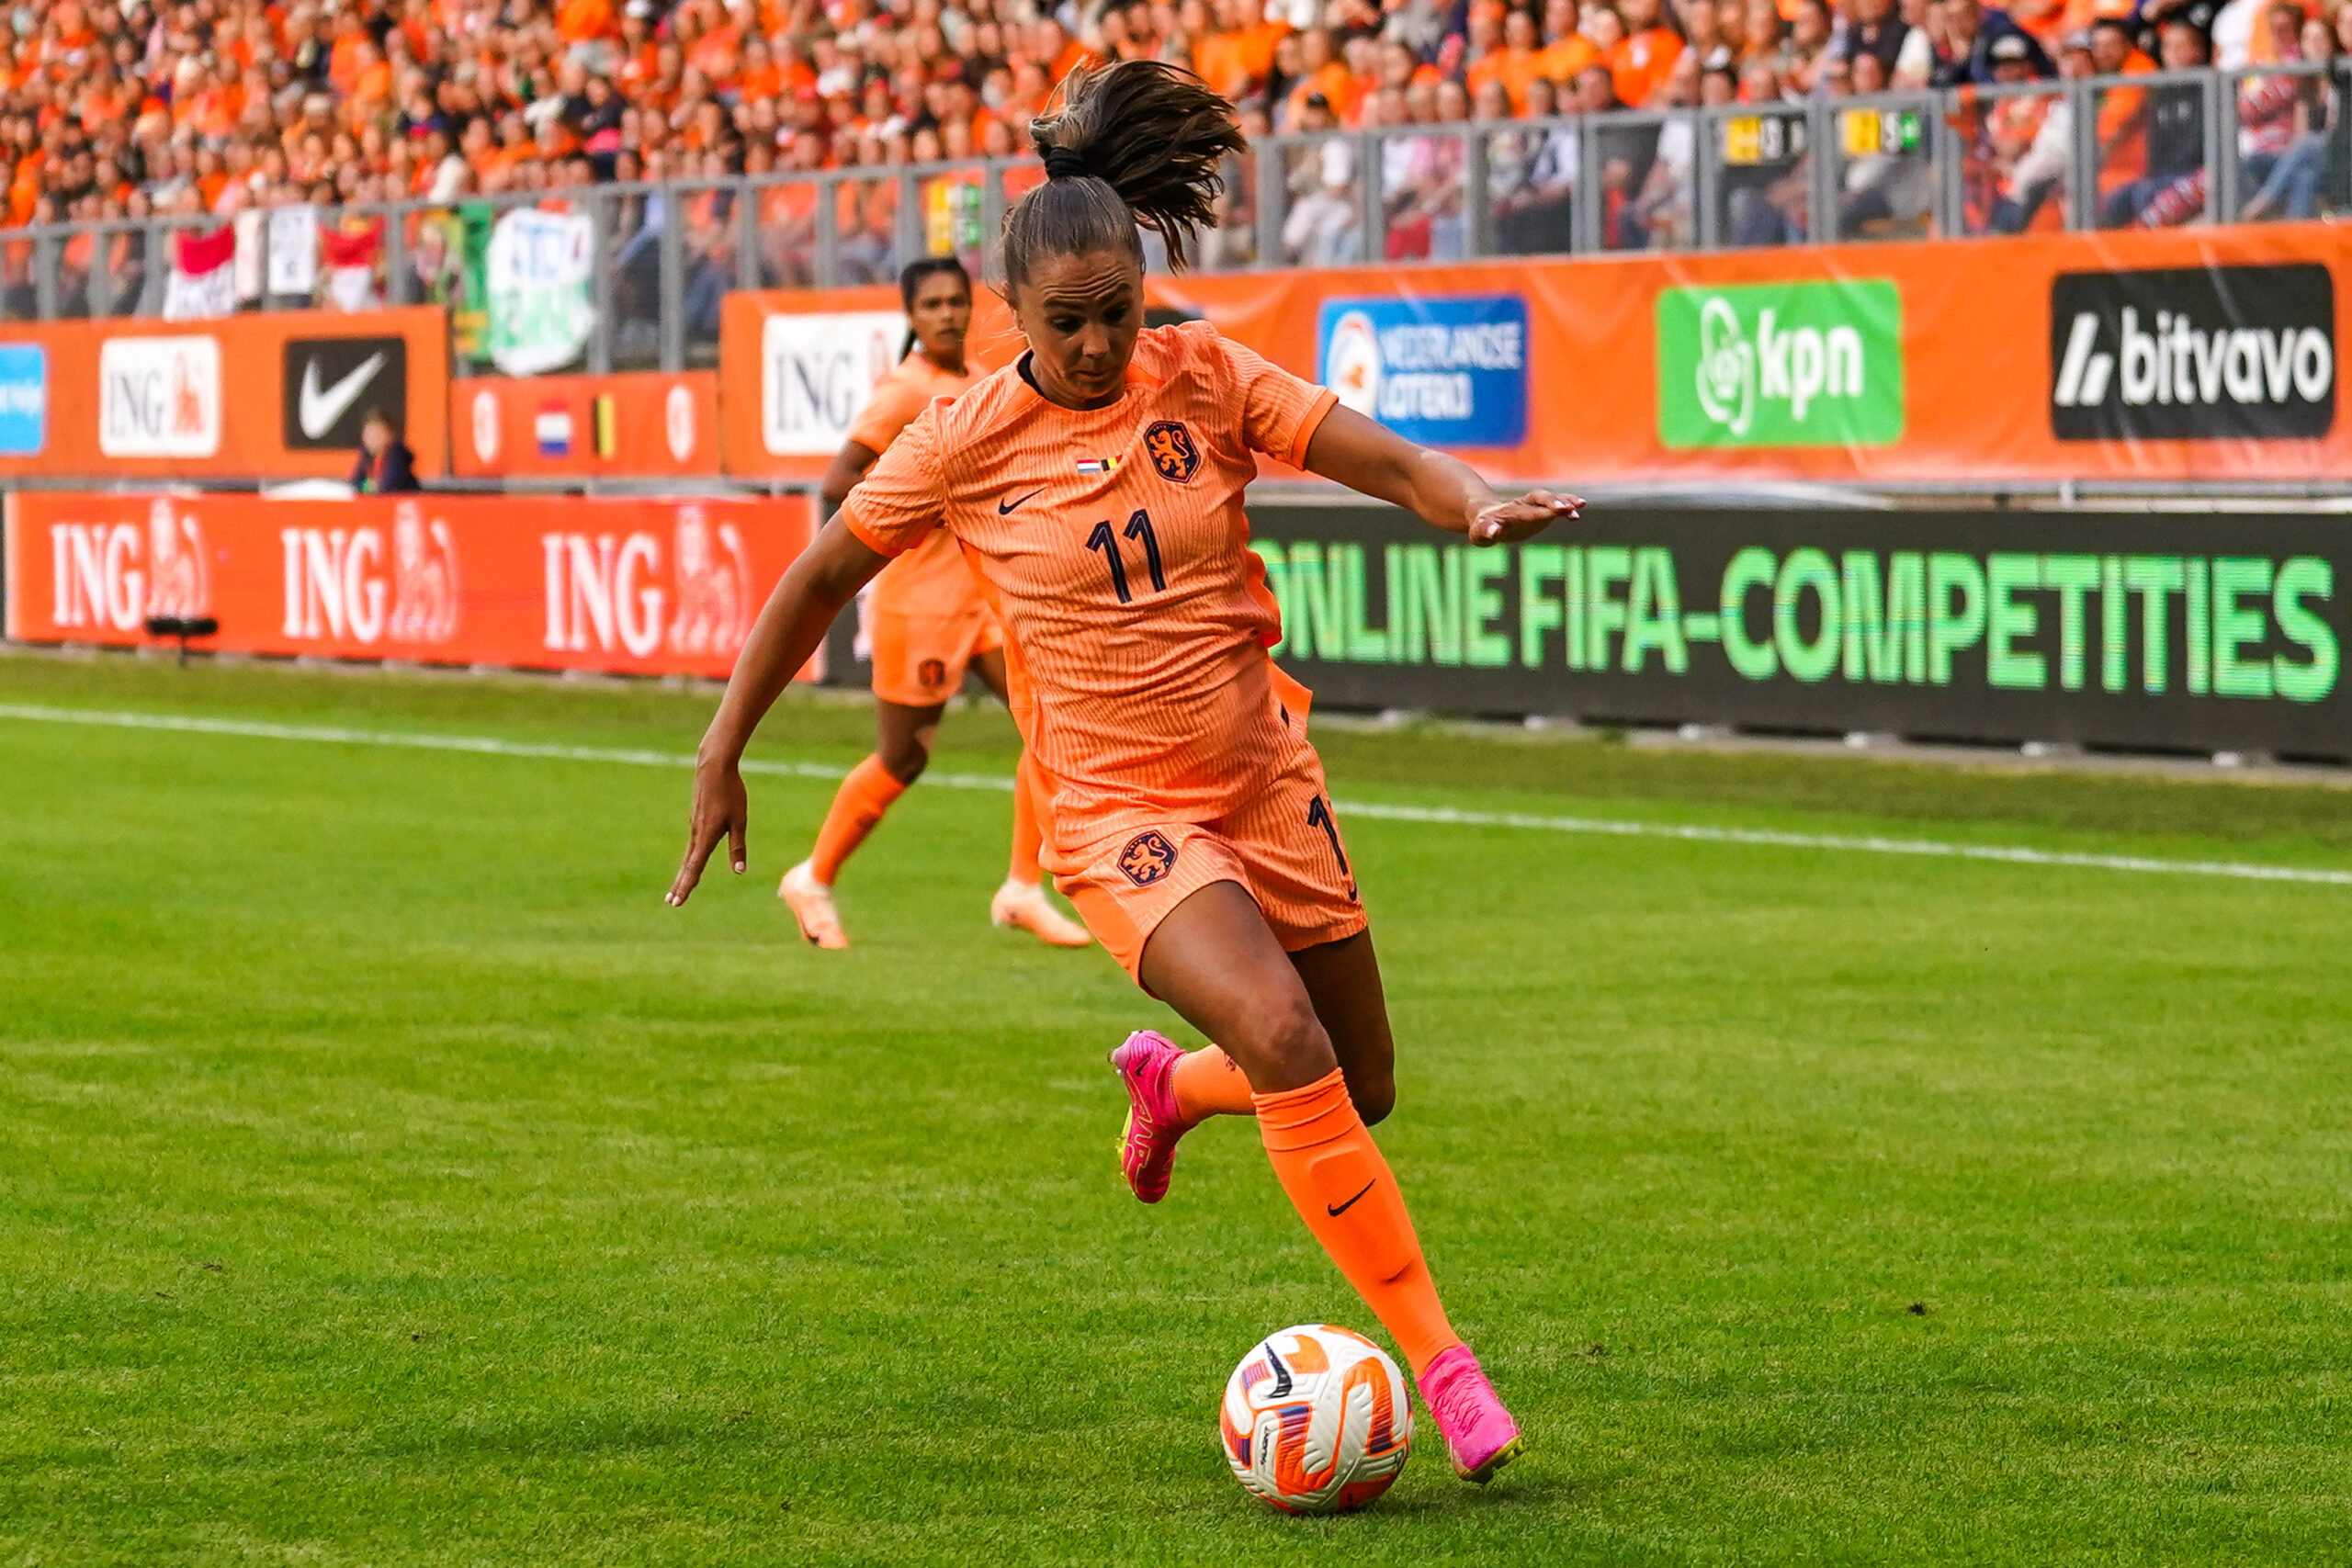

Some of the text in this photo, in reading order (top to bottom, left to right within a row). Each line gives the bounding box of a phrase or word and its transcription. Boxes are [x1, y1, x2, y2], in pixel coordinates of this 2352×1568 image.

[107, 370, 164, 437] ING
[775, 352, 854, 433] ING
[1758, 308, 1863, 421] kpn
[2120, 306, 2333, 405] bitvavo
[50, 522, 143, 631] ING
[281, 526, 388, 643] ING
[543, 532, 664, 657] ING
[1085, 507, 1167, 604] 11
